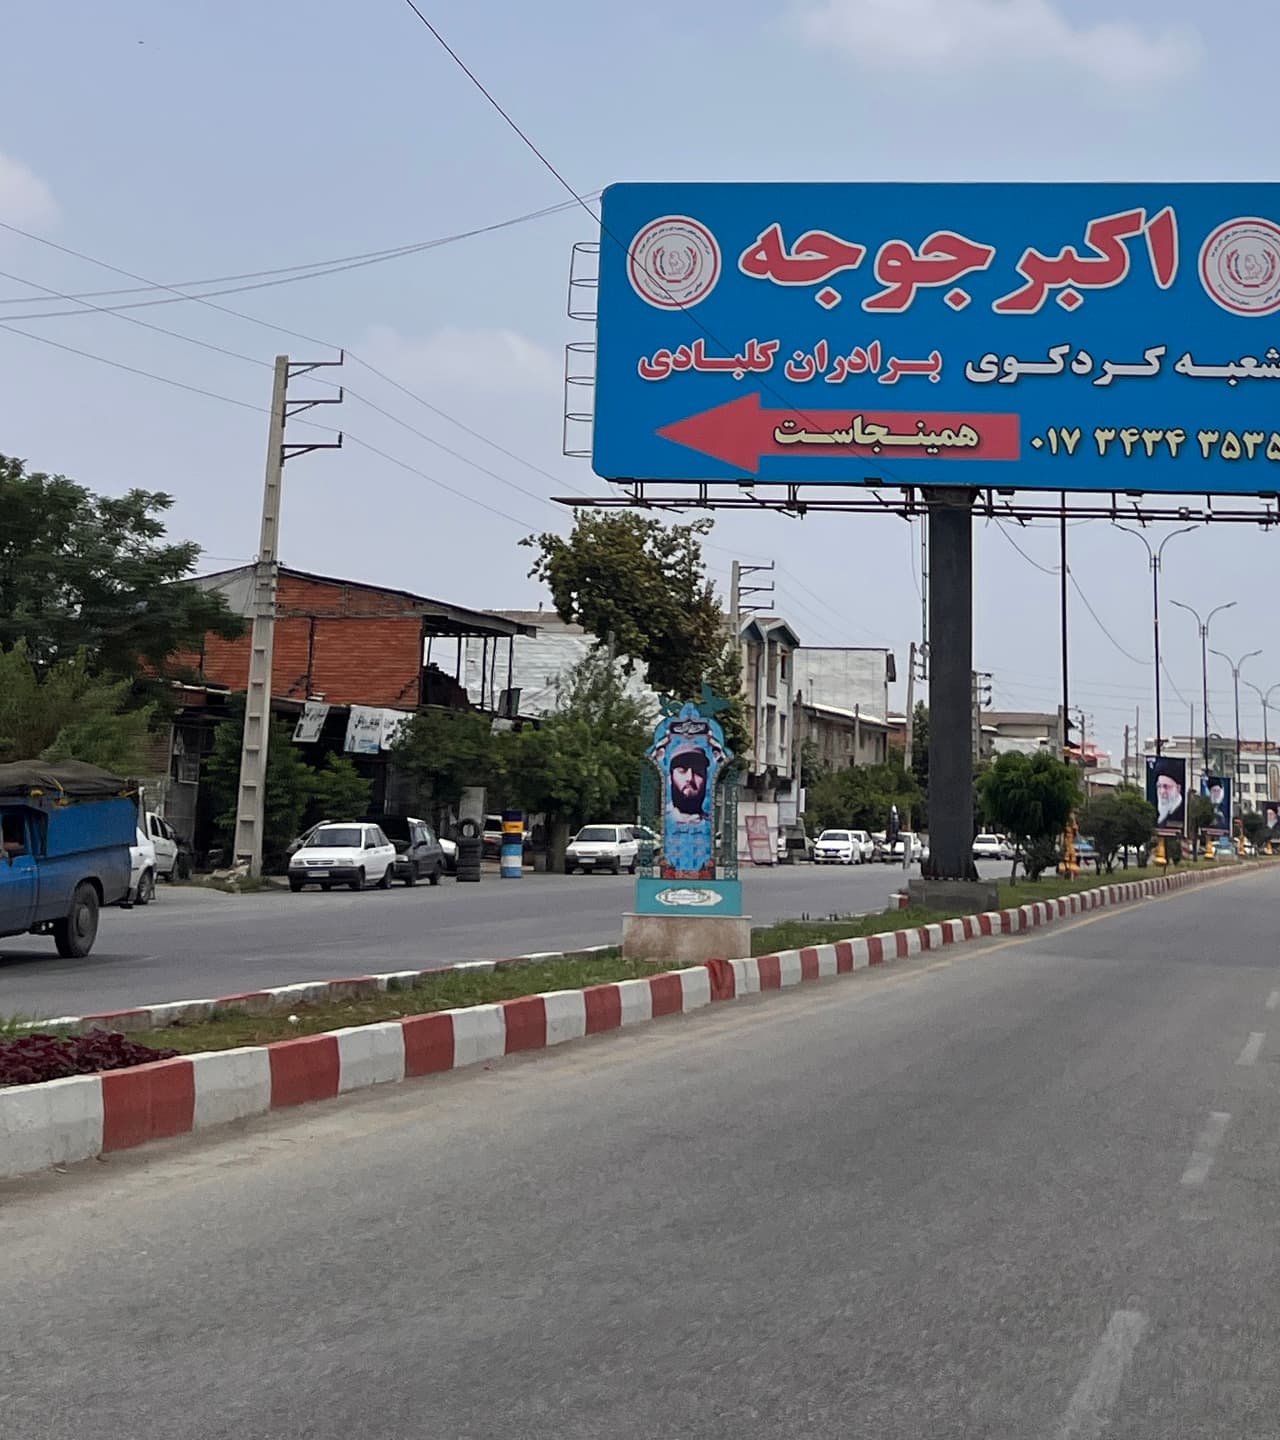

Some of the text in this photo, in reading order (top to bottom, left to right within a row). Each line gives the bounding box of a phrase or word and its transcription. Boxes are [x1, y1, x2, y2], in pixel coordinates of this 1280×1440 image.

[738, 222, 994, 313] جوجه
[992, 206, 1179, 314] اکبر
[637, 338, 943, 385] برادران کلبادی
[964, 344, 1166, 386] کردکوی
[773, 415, 980, 453] همینجاست
[1031, 427, 1081, 455] ۰۱۷
[1094, 428, 1186, 458] ۳۴۳۴
